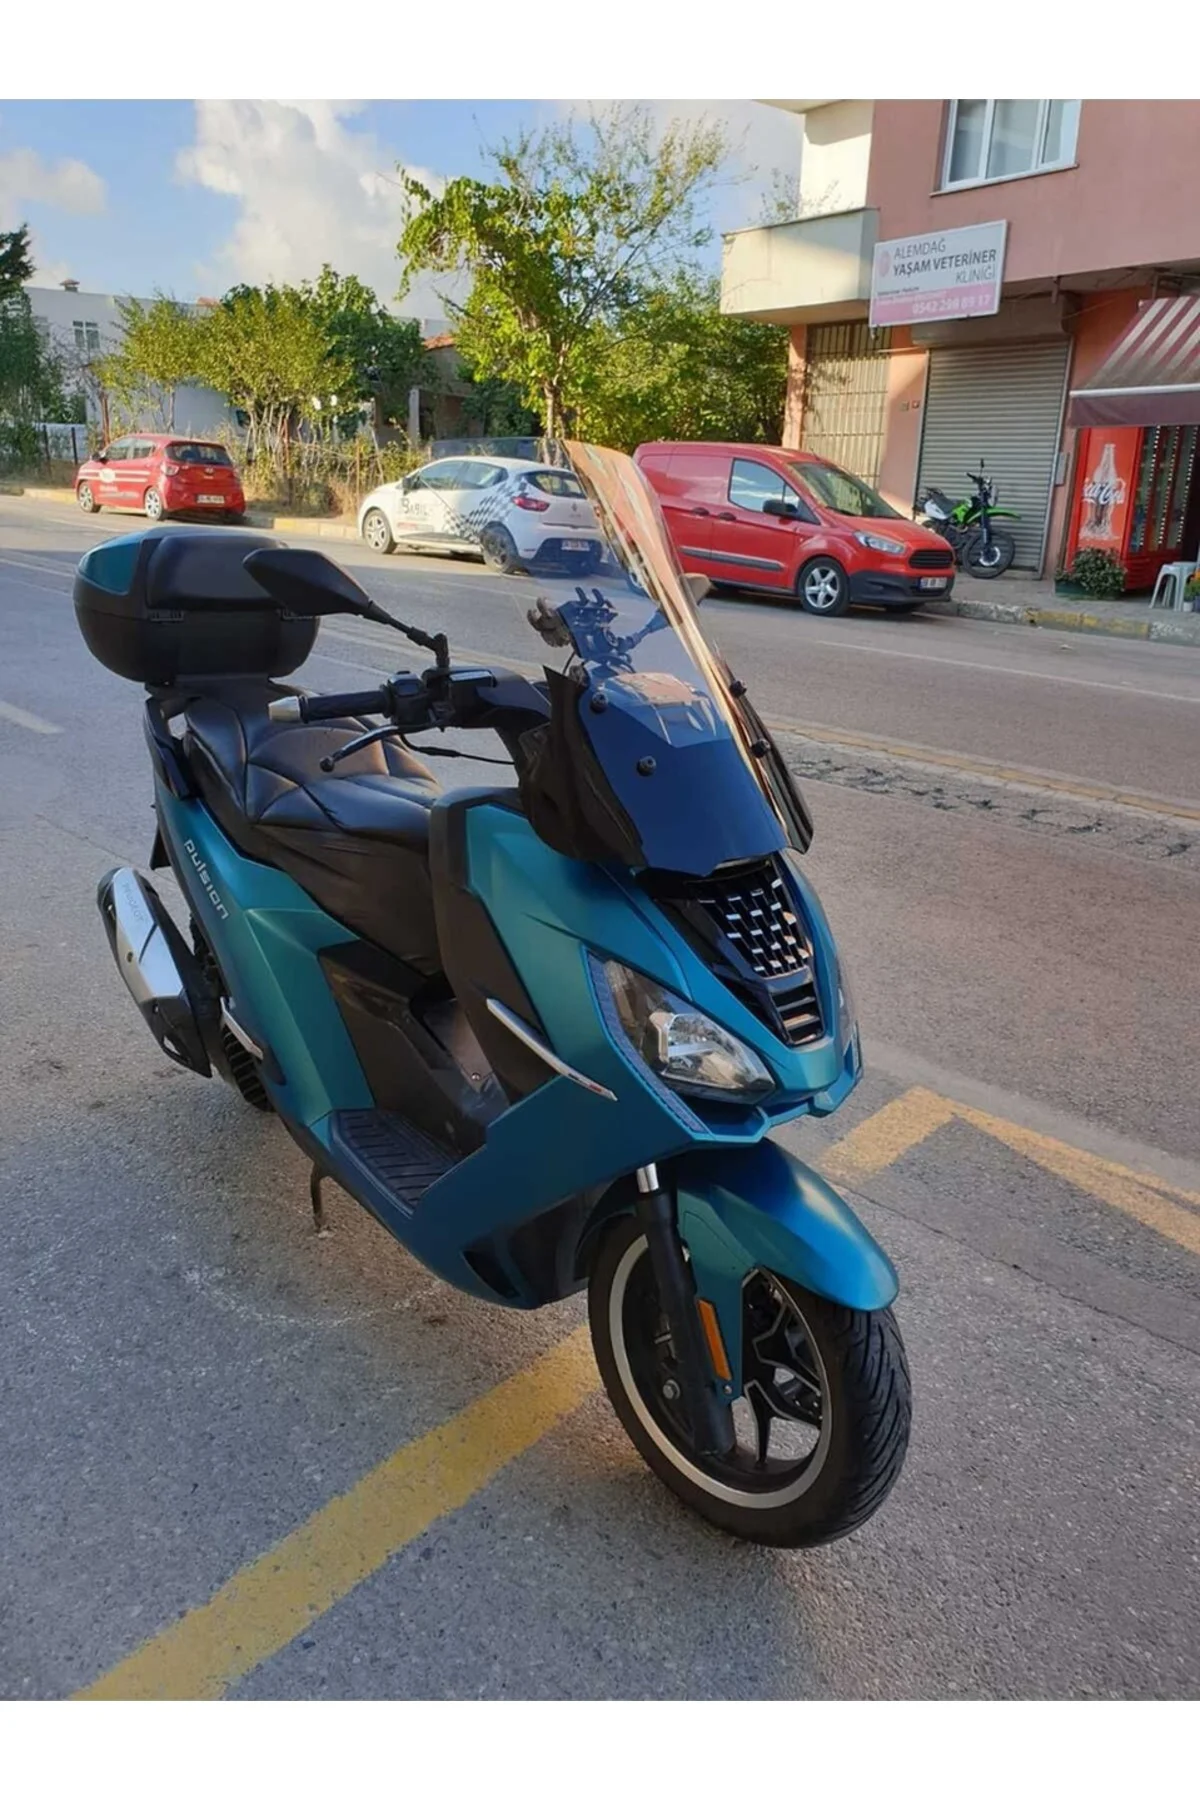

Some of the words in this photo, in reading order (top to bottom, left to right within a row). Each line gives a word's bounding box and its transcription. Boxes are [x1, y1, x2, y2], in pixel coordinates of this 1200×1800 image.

[894, 238, 946, 260] ALEMDAĞ
[893, 259, 931, 277] YAŞAM
[933, 249, 997, 271] VETERİNER
